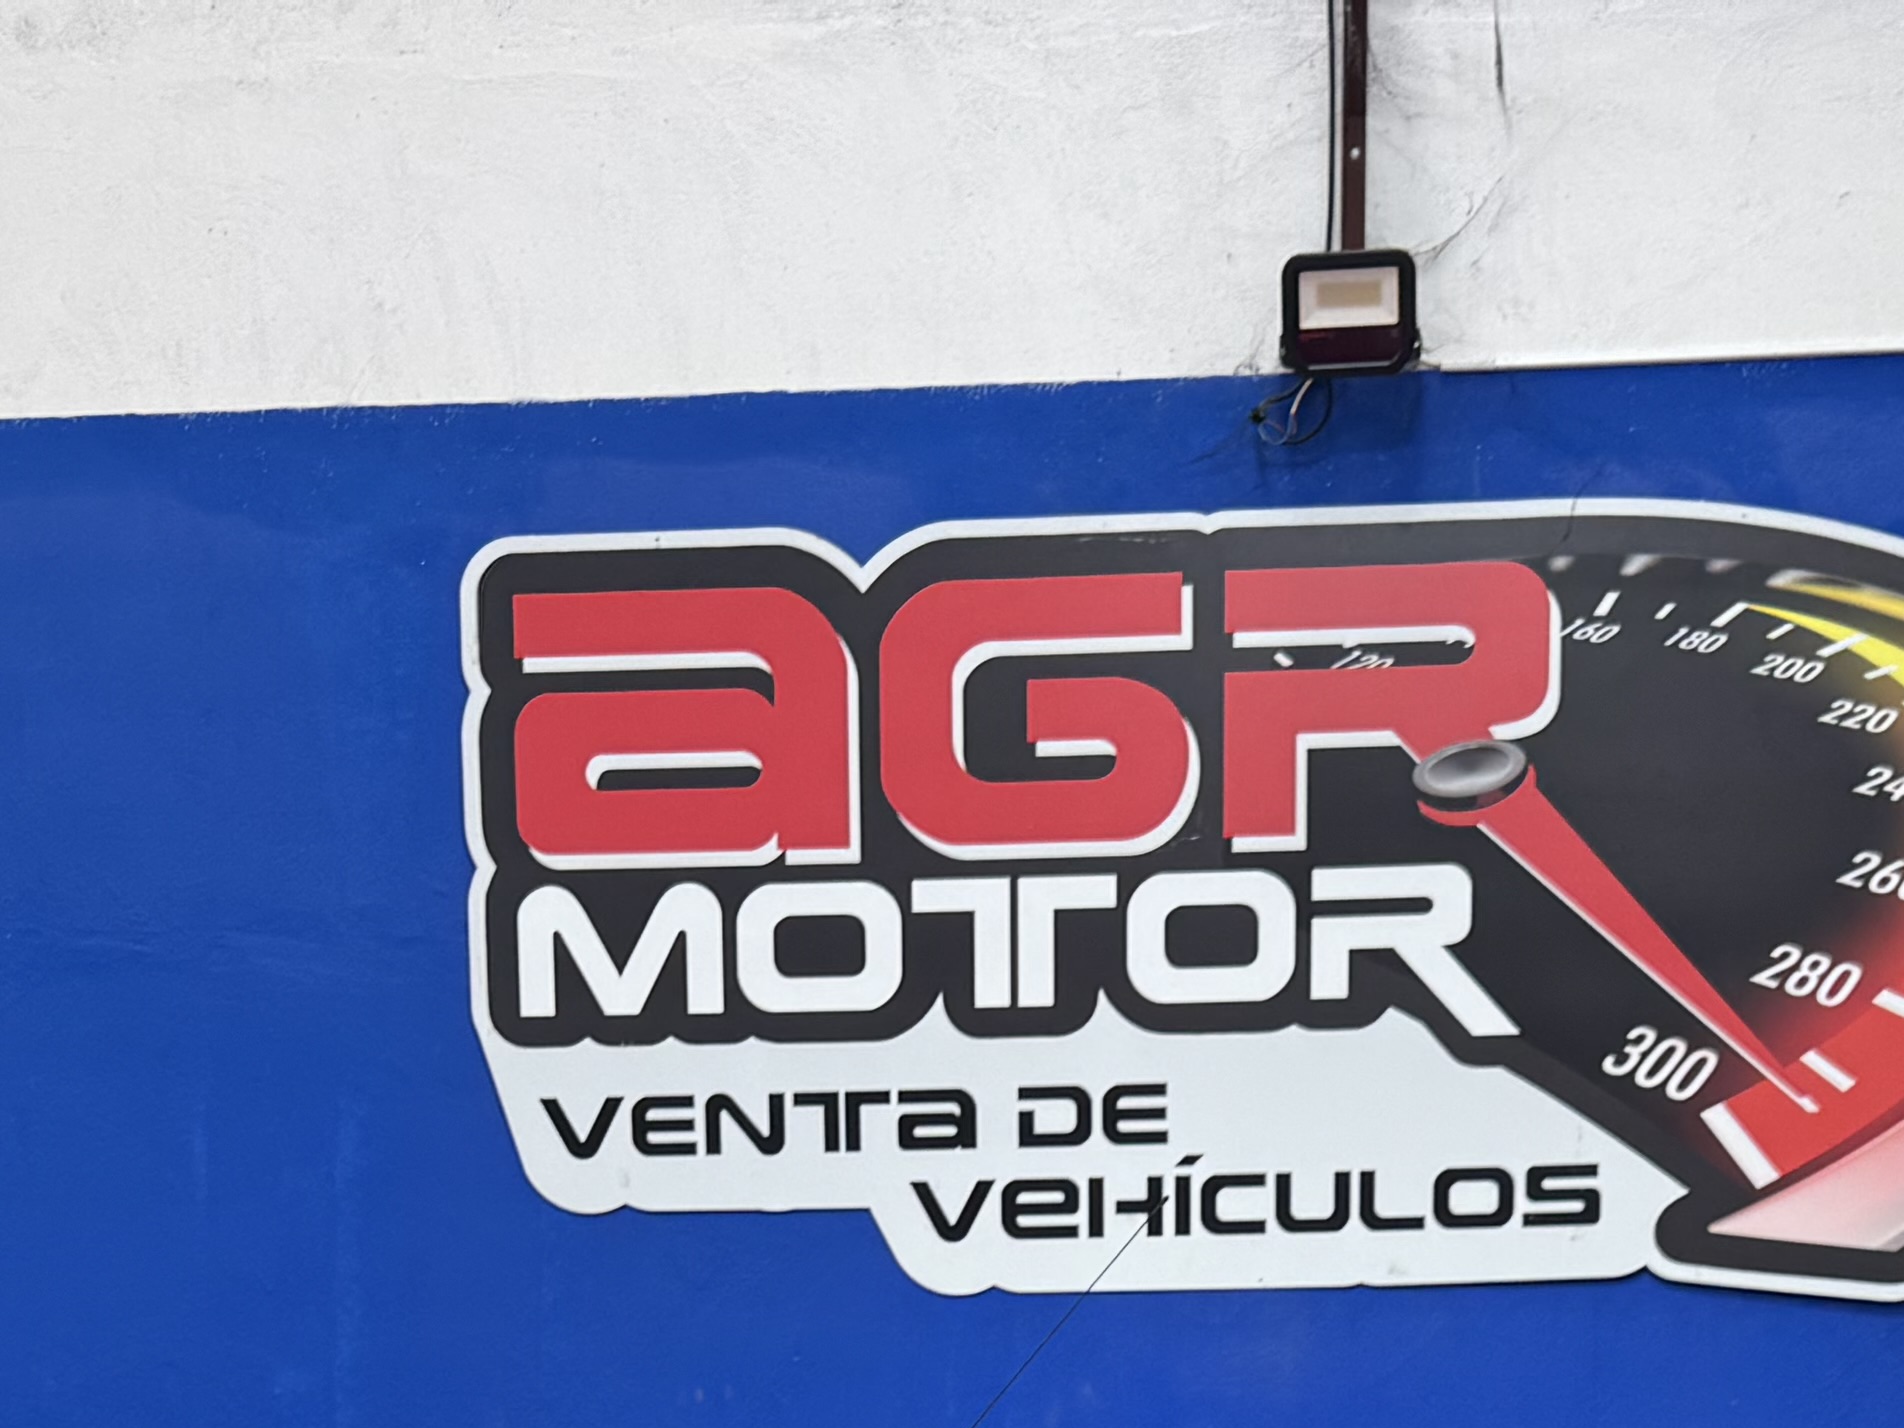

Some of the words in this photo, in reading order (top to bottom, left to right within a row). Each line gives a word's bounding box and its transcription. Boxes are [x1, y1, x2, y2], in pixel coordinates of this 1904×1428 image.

[1560, 617, 1621, 646] 160
[1663, 626, 1729, 654] 180
[1749, 653, 1827, 684] 200
[1817, 698, 1899, 734] 220
[516, 863, 1521, 1038] MOTOR
[1749, 942, 1864, 1008] 280
[1601, 1025, 1719, 1102] 300
[1016, 1082, 1170, 1149] DE
